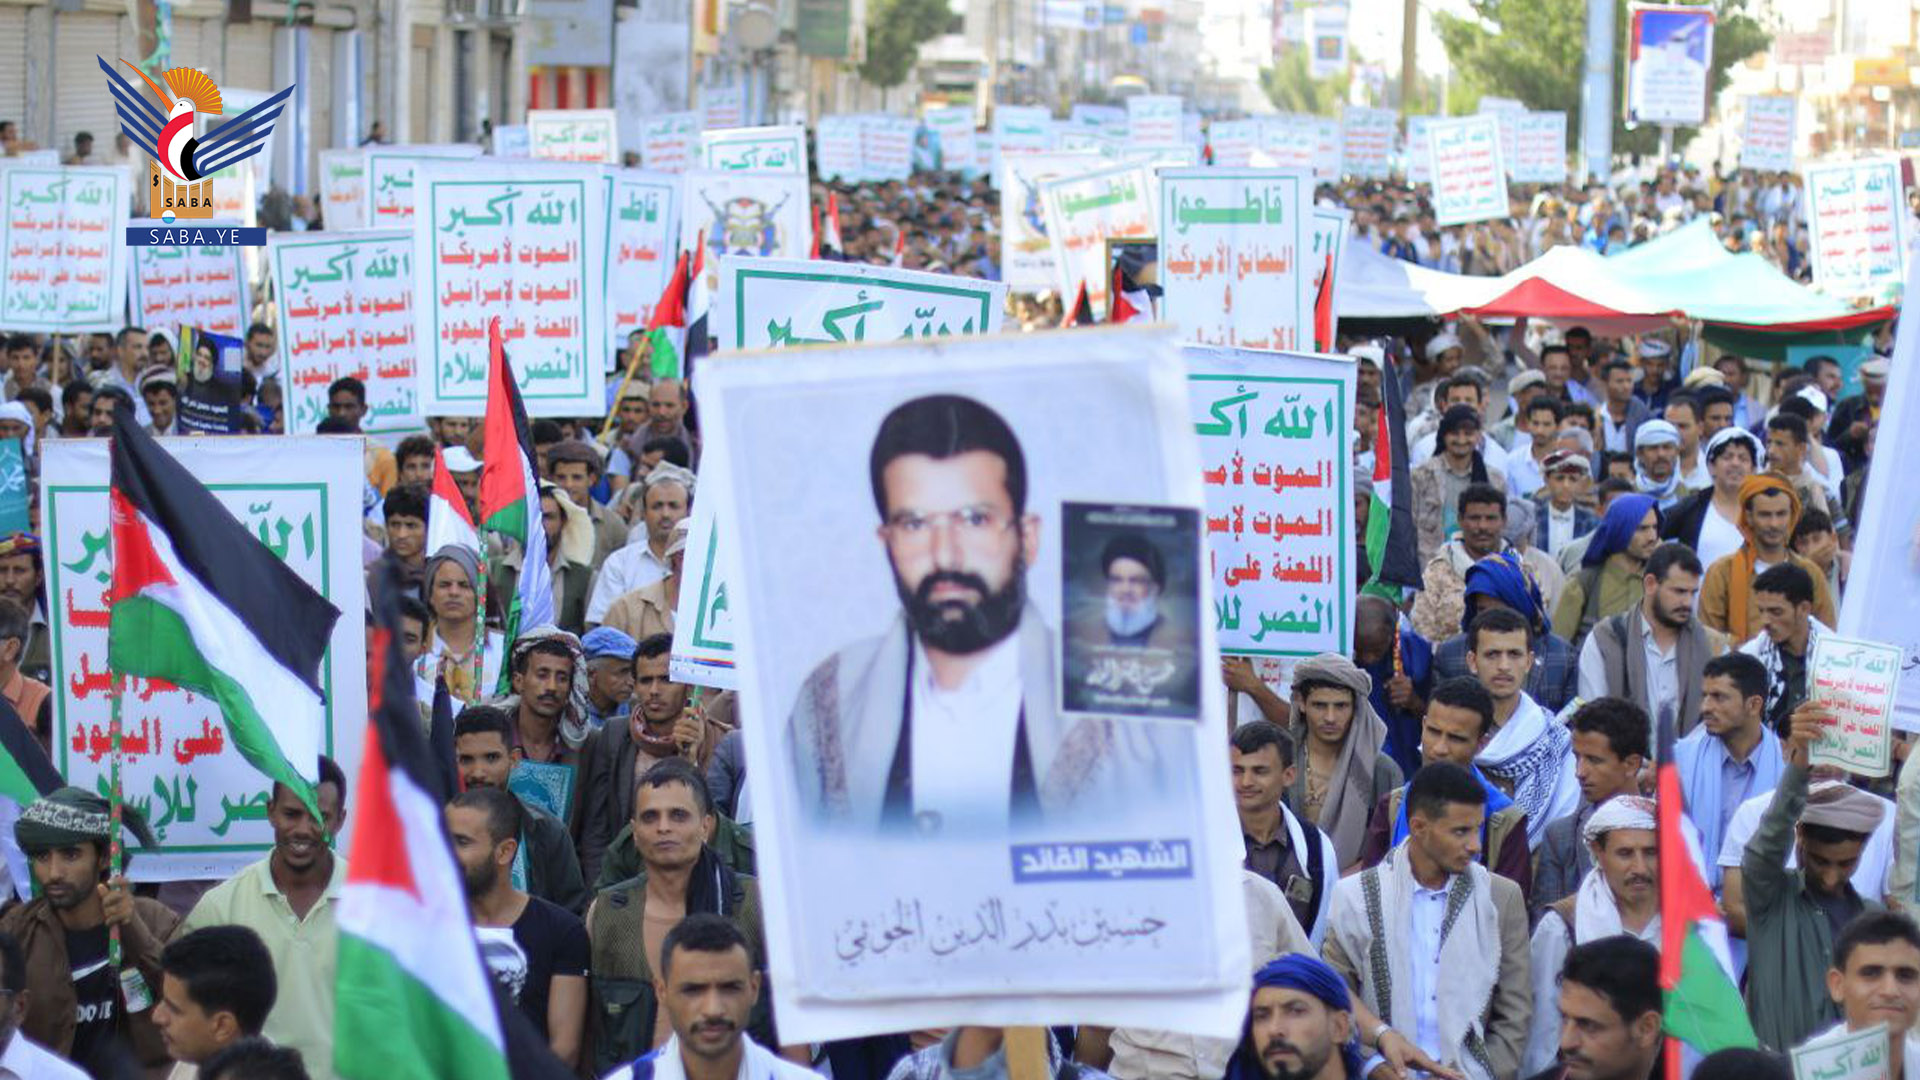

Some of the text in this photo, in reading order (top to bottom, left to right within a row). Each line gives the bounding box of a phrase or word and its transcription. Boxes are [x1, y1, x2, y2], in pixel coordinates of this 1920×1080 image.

[12, 179, 112, 211] الله أكبر
[439, 186, 577, 238] الله أكبر
[1171, 186, 1283, 235] قاطعوا
[285, 245, 411, 293] الله أكبر
[440, 236, 578, 270] الموت لأمريكا
[1166, 239, 1294, 281] البضائع الأمريكية
[287, 289, 412, 321] الموت لأمريكا
[440, 278, 579, 309] الموت لإسرائيل
[361, 323, 414, 351] الموت
[498, 315, 526, 345] على
[534, 314, 579, 338] اللعنة
[376, 355, 418, 378] اللعنة
[519, 347, 580, 389] النصر
[364, 385, 419, 427] النصر
[1194, 383, 1334, 440] الله أك
[1252, 458, 1332, 495] الموت
[1252, 506, 1332, 543] الموت
[1224, 552, 1262, 588] على
[1271, 551, 1332, 585] اللعنة
[1249, 592, 1333, 643] النصر
[173, 716, 225, 765] على
[1020, 839, 1188, 877] الشهيد القائد
[928, 897, 1007, 957] الدين
[1009, 899, 1070, 952] بدر
[1070, 907, 1167, 950] حسين
